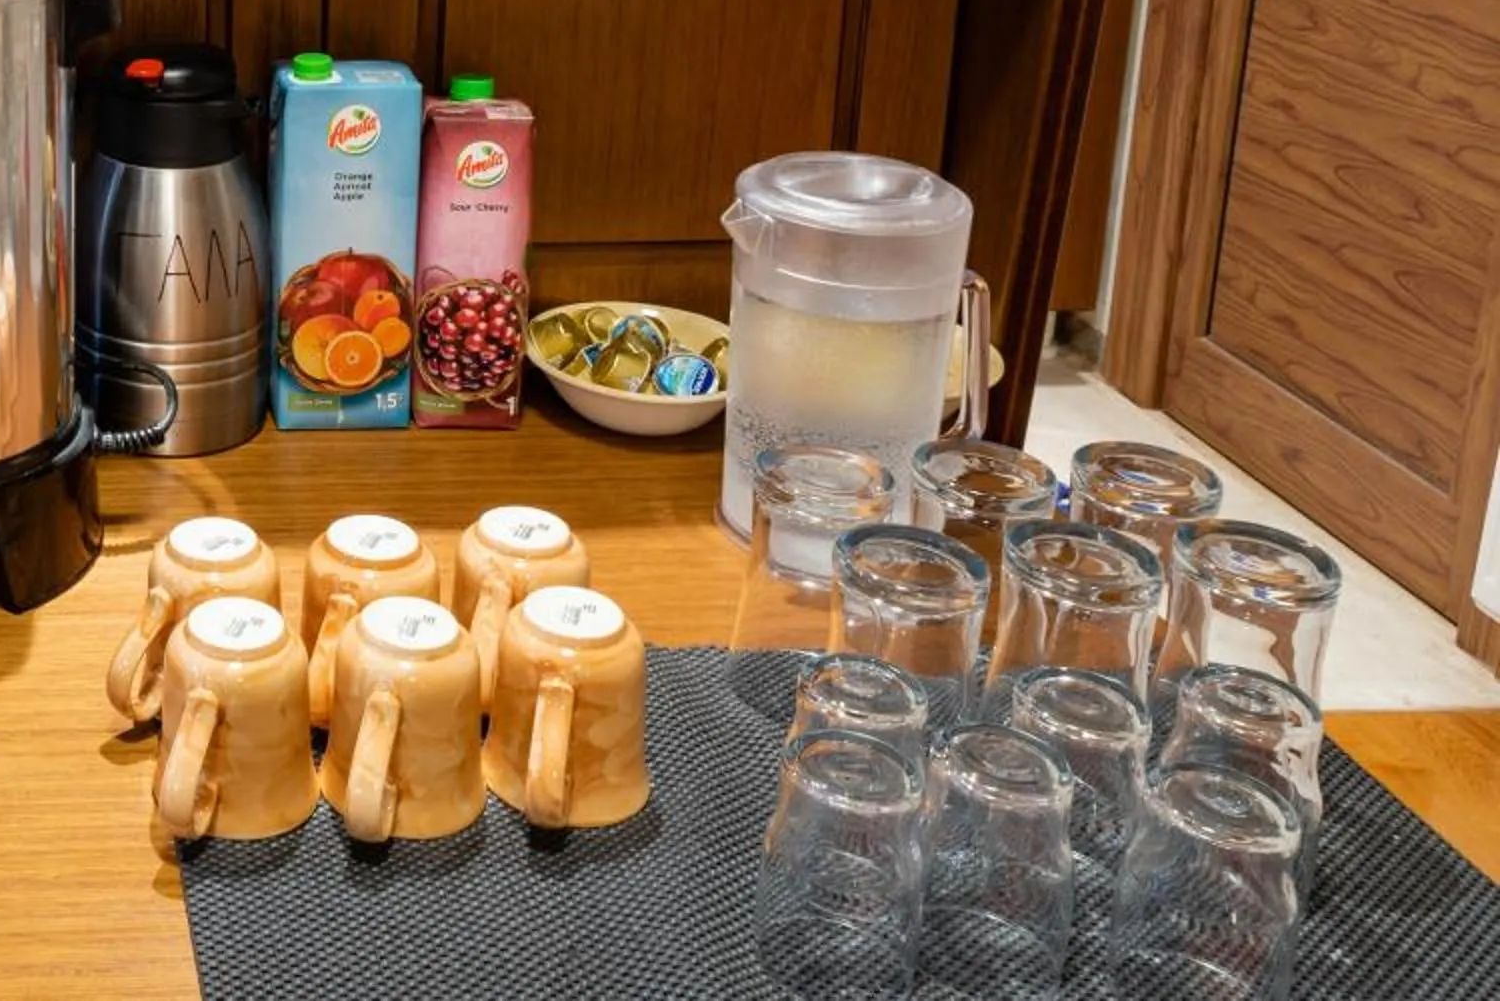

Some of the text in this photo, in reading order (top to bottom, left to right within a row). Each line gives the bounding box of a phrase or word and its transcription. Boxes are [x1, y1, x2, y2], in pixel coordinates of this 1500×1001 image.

[328, 114, 377, 148] Amita
[456, 150, 503, 181] Amita
[334, 172, 373, 181] Orange
[333, 182, 372, 192] Apricot
[333, 193, 364, 202] Apple
[450, 202, 509, 214] Sour Cherry
